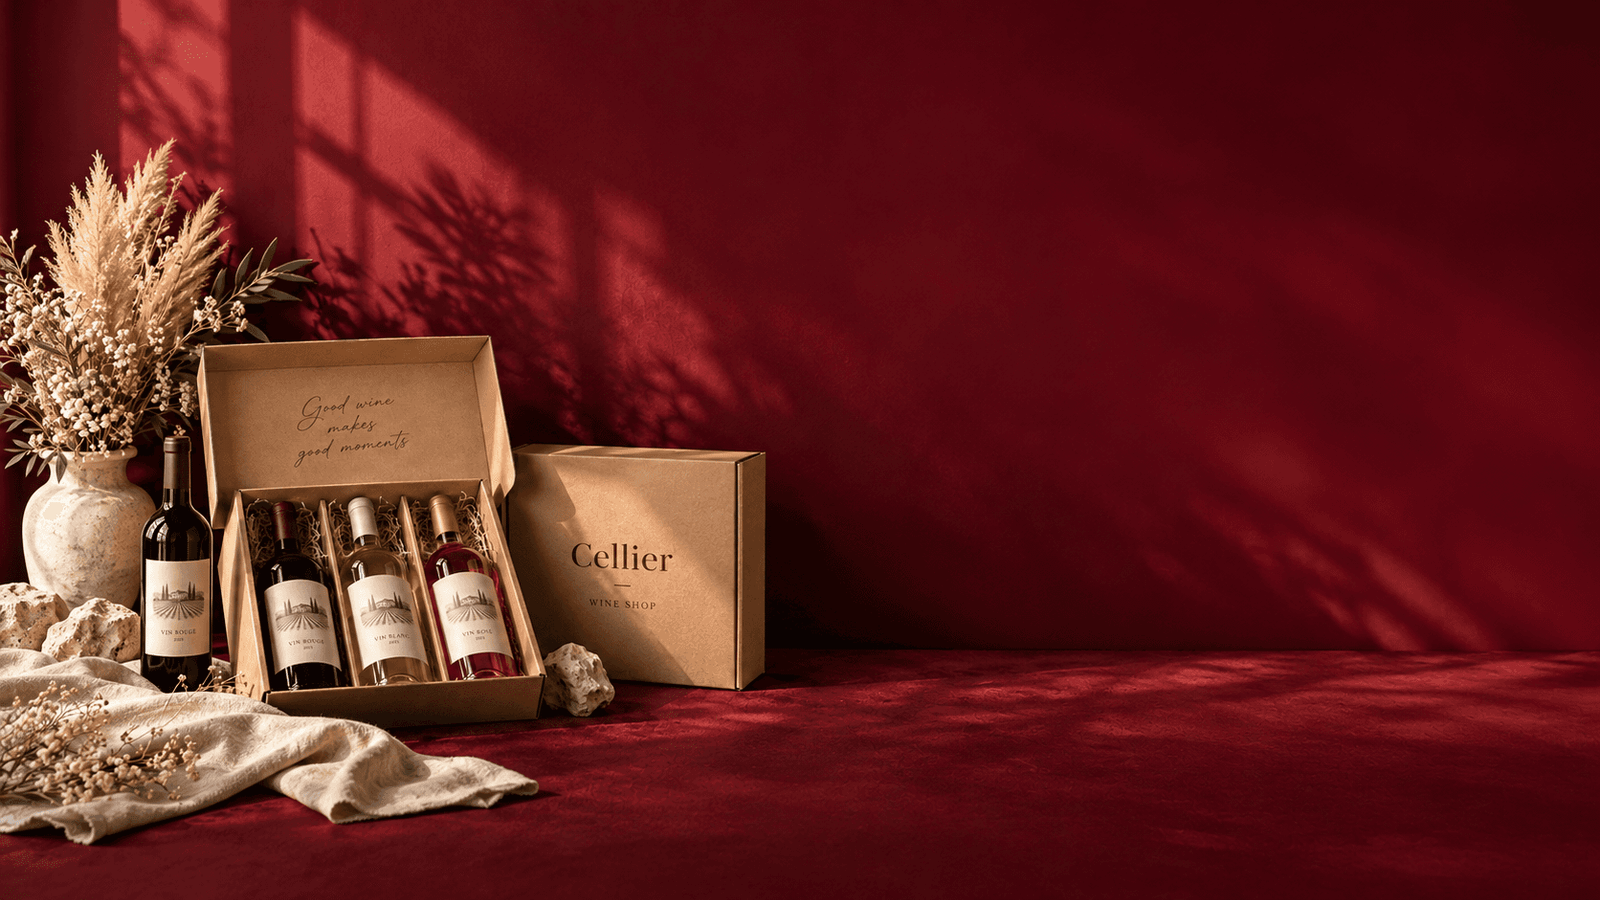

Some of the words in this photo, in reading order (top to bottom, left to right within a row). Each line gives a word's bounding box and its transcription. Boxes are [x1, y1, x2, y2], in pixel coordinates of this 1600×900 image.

[297, 395, 350, 431] Good
[356, 398, 395, 410] wine
[327, 414, 377, 434] makes
[293, 439, 334, 468] good
[340, 430, 410, 453] moments
[571, 542, 674, 572] Cellier
[589, 599, 620, 608] WINE
[624, 601, 656, 610] SHOP
[374, 634, 387, 642] VIN
